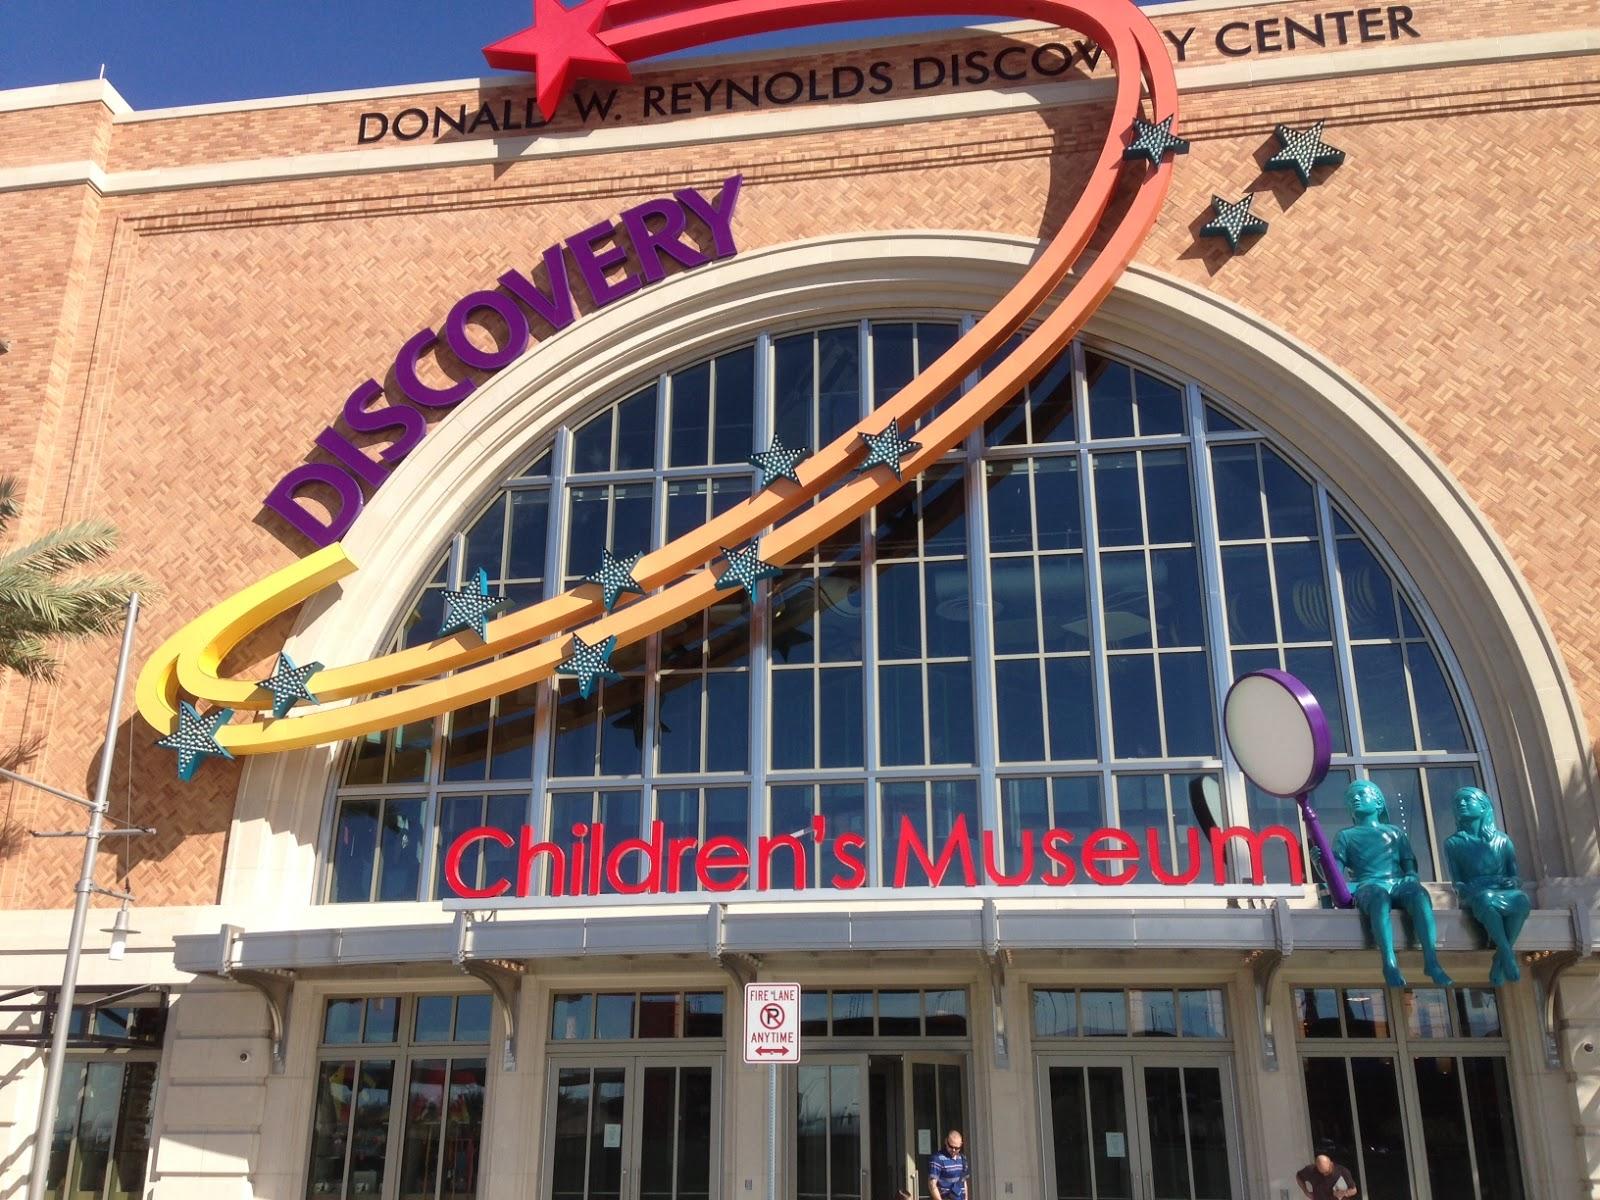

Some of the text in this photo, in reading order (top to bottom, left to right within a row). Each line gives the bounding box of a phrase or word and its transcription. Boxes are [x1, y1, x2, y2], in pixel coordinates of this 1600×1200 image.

[358, 5, 1421, 145] DONALD W. REYNOLDS DISCOVY CENTER
[262, 173, 744, 548] DISCOVERY
[444, 813, 1302, 899] Children's Museum
[750, 990, 795, 1001] FIRE LANE
[751, 1032, 793, 1043] ANYTIME
